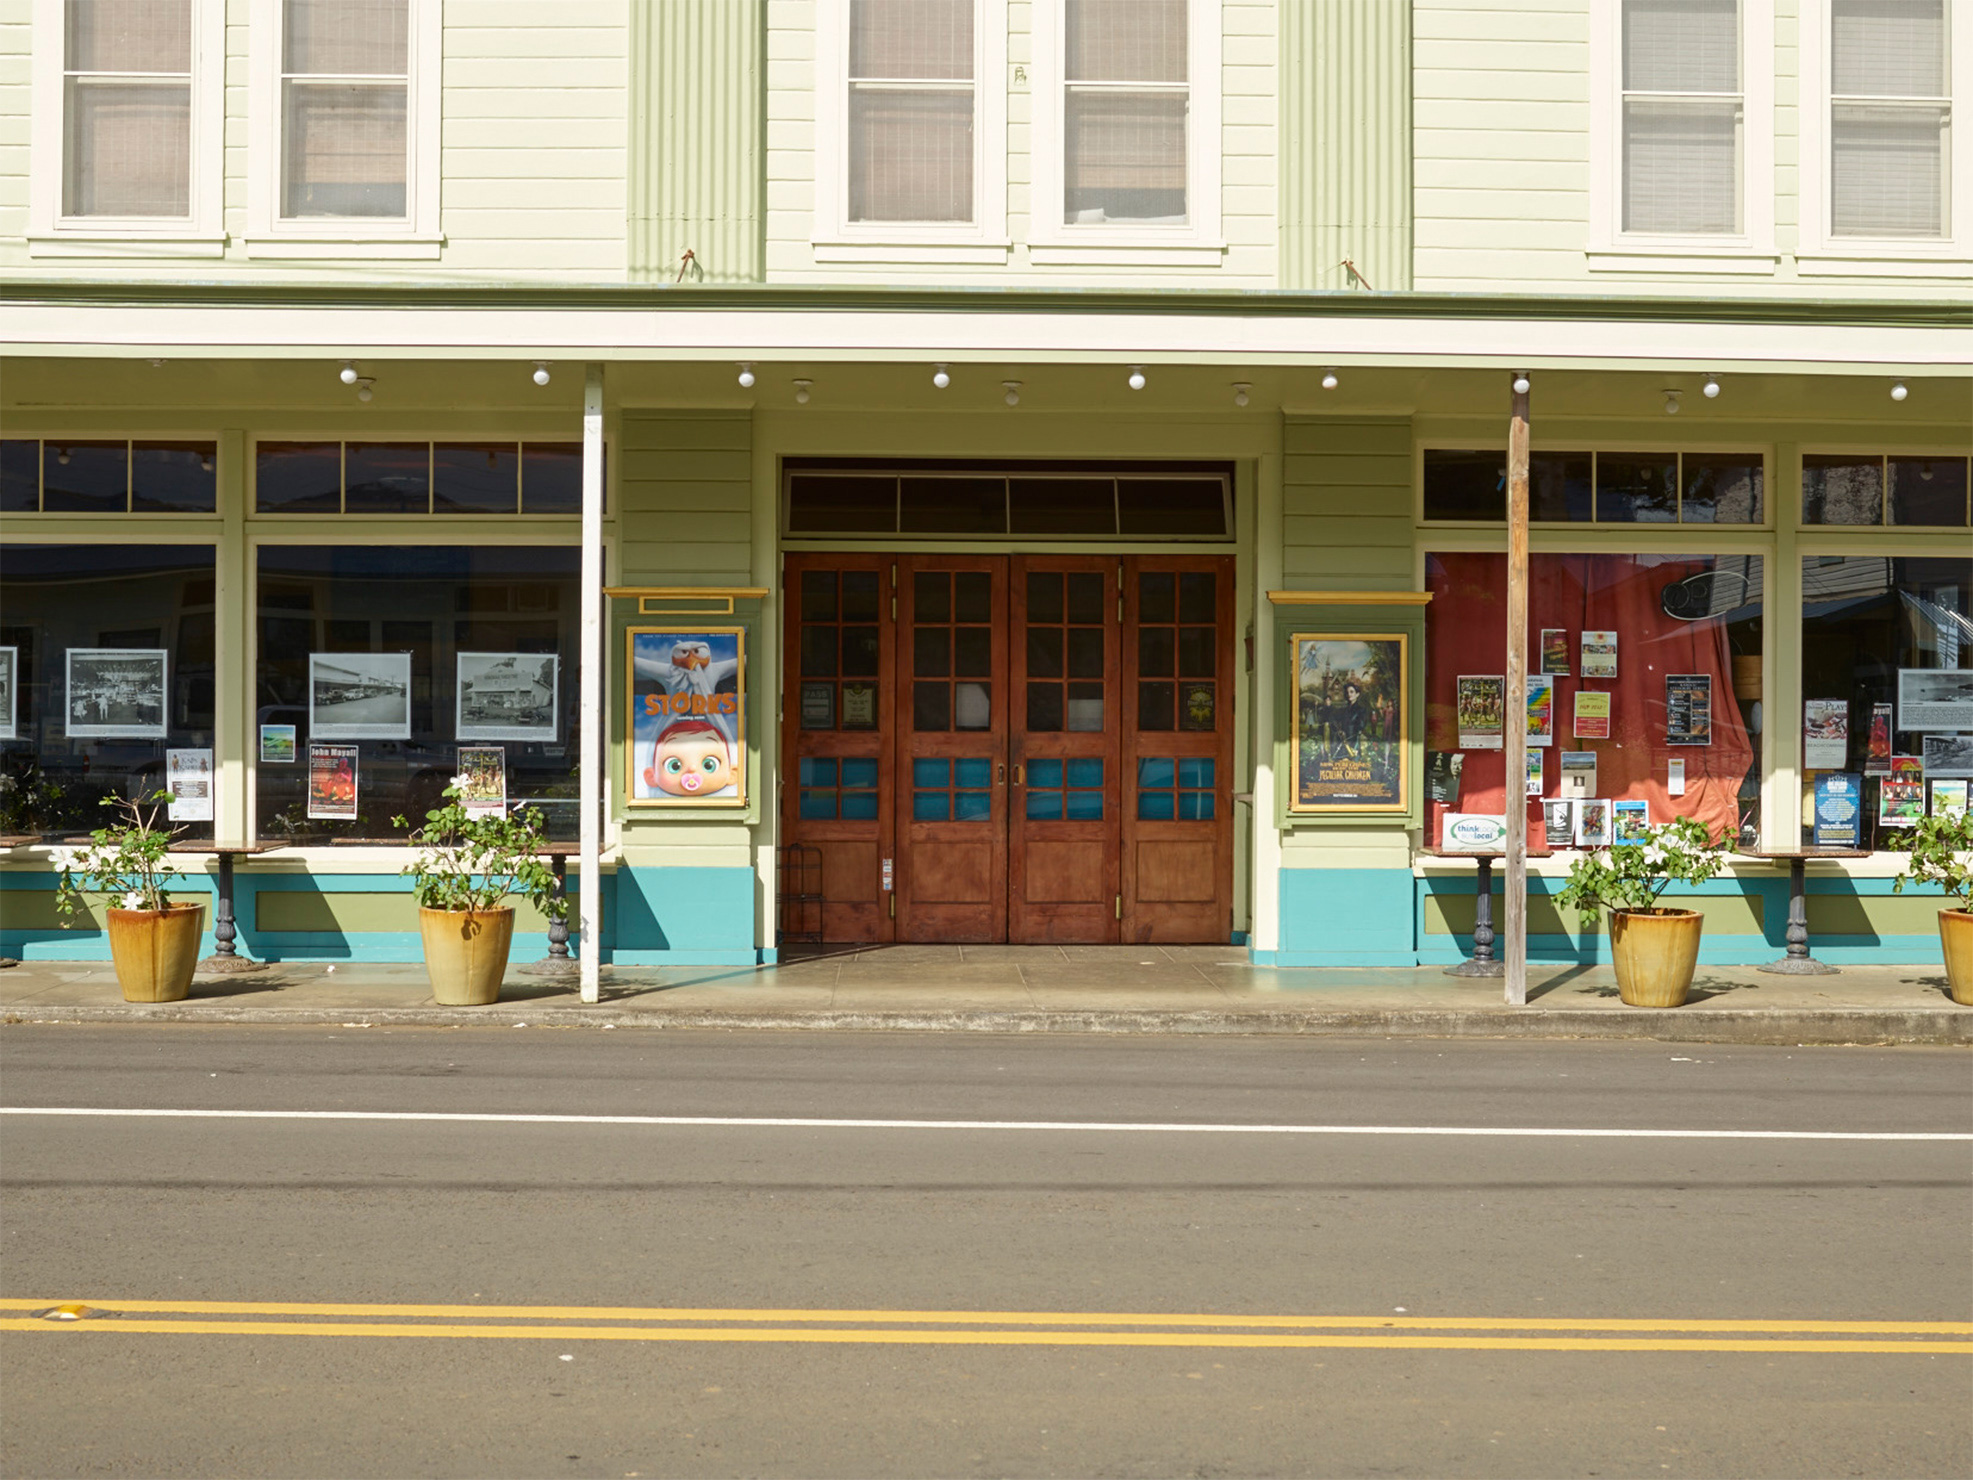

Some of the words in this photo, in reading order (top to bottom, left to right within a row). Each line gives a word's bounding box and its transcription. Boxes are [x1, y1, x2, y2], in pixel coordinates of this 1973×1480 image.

[645, 691, 736, 715] STORKS
[311, 747, 330, 756] John
[330, 748, 356, 758] Mayall
[1457, 824, 1479, 832] think
[1474, 832, 1493, 840] local
